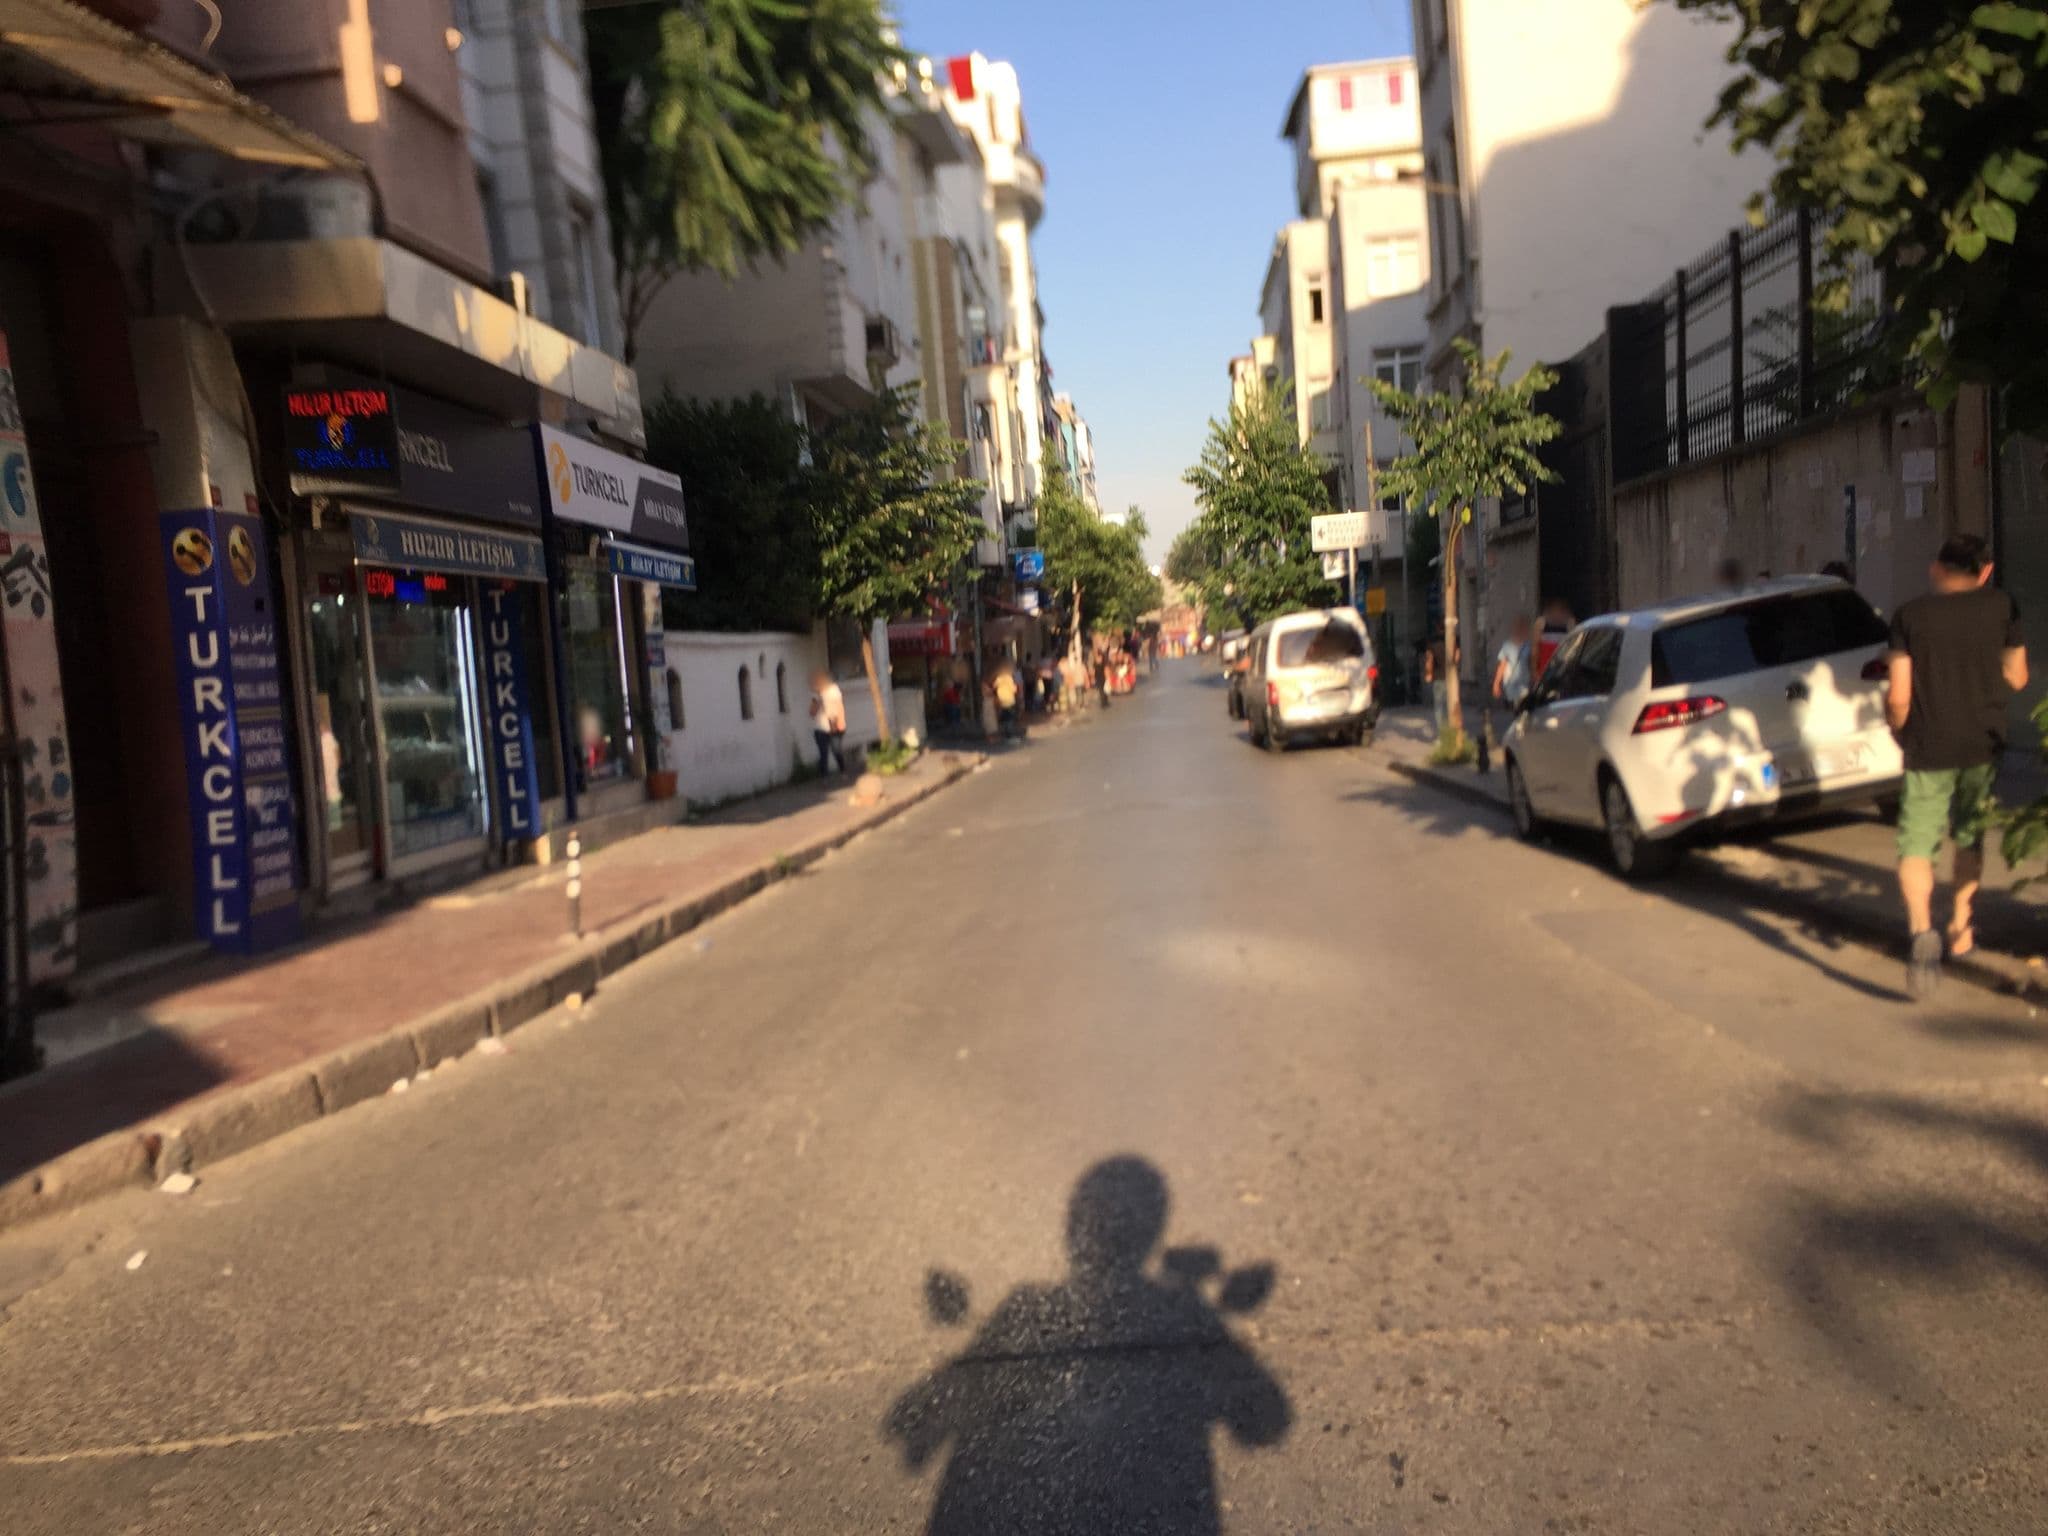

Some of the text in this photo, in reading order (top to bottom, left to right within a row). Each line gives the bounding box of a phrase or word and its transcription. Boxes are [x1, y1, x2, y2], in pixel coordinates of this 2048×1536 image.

[400, 529, 456, 561] HUZUR
[571, 462, 629, 507] TURKCELL
[185, 585, 239, 936] TURKCELL
[488, 590, 529, 829] TURKCELL
